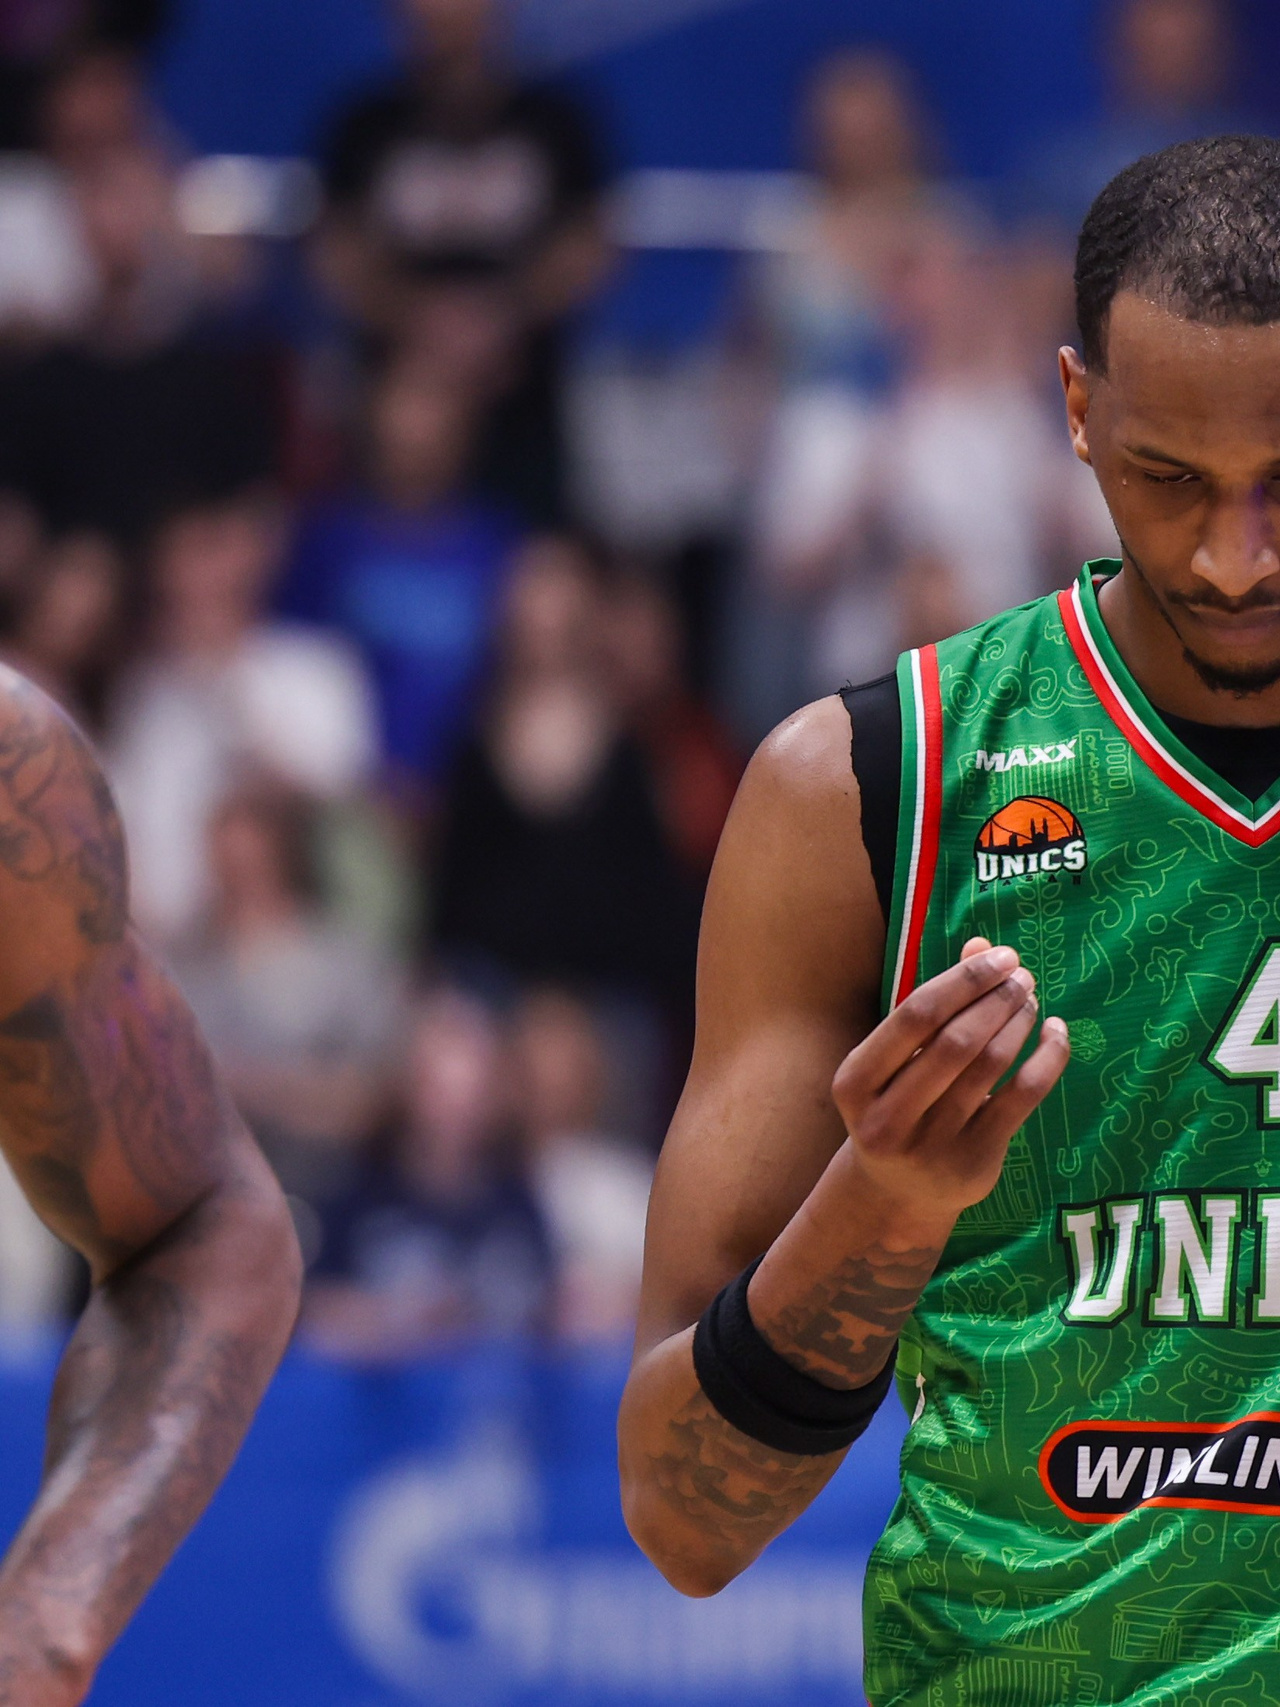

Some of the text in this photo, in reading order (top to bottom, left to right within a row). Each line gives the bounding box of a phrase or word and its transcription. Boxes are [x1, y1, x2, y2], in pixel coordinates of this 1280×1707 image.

[975, 738, 1078, 773] MAXX
[975, 838, 1087, 884] UNICS
[978, 873, 1082, 894] KAZAN
